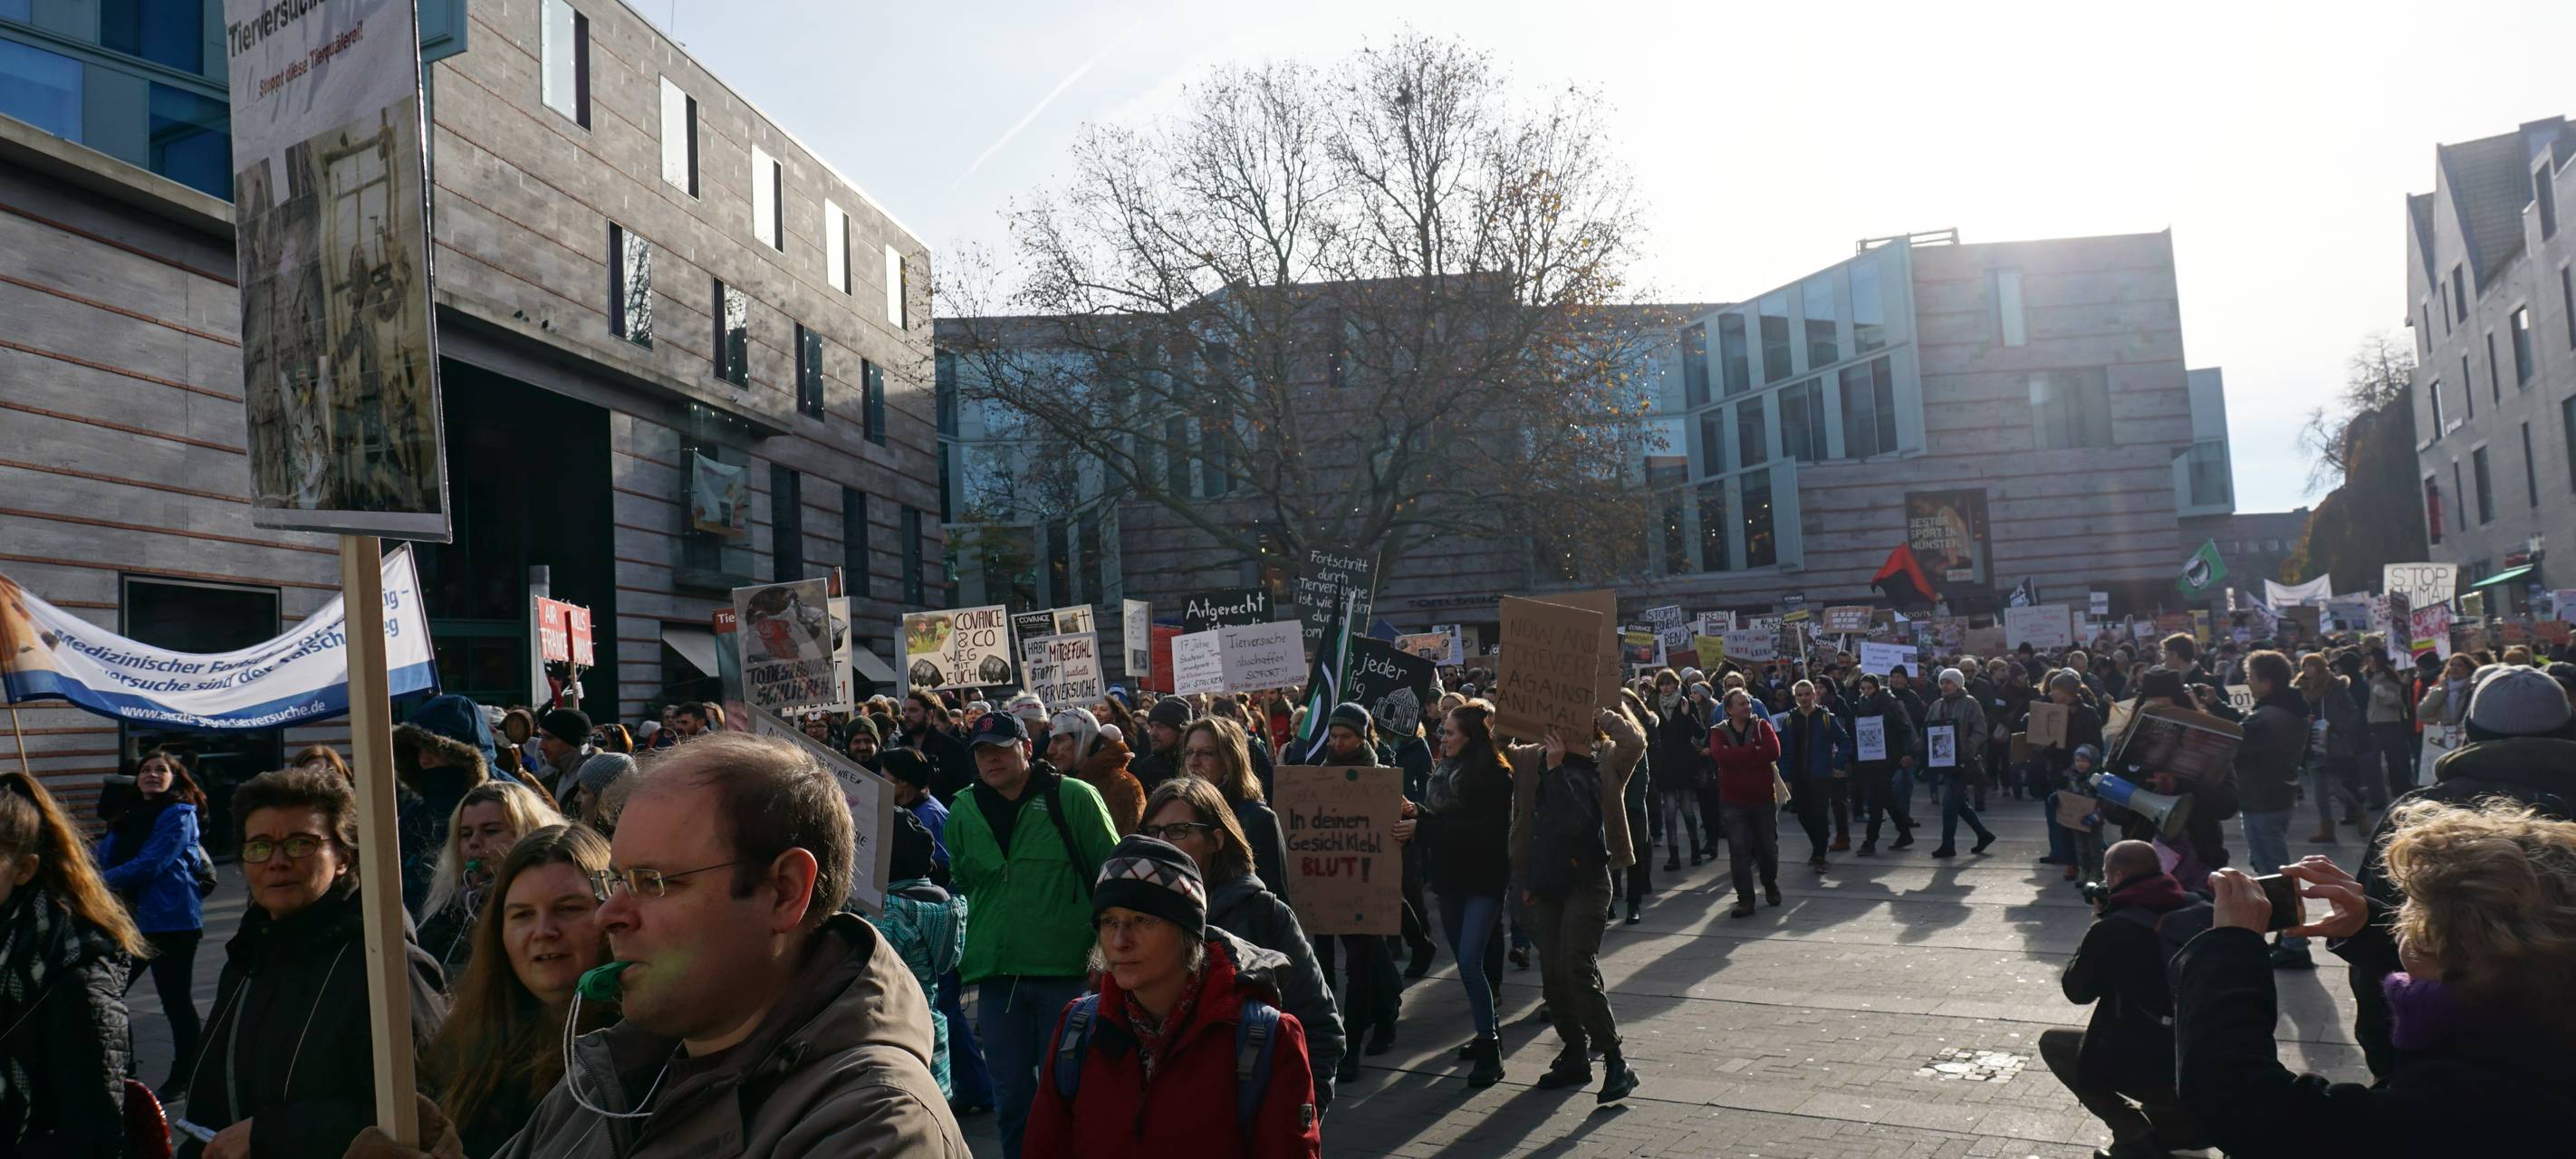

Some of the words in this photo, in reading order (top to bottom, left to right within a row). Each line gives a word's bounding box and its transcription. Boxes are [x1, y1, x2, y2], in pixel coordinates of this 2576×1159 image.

[259, 69, 284, 97] Stoppt
[285, 58, 308, 82] diese
[309, 20, 363, 69] Tierquälerei!
[1312, 550, 1369, 572] Fortschritt
[1317, 567, 1349, 585] durch
[2391, 567, 2449, 588] STOP
[1186, 591, 1265, 621] Artgerecht
[1298, 591, 1313, 606] ist
[1316, 596, 1333, 608] wie
[717, 613, 735, 624] Tie
[955, 608, 1004, 631] COVANCE
[1018, 614, 1051, 625] COVANCE
[1648, 607, 1678, 621] STOPPT
[957, 632, 968, 648] &
[972, 629, 995, 647] CO
[1226, 633, 1287, 649] Tierversuche
[1509, 618, 1555, 646] NOW
[54, 627, 206, 674] Medizinischer
[943, 648, 976, 663] WEG
[1028, 641, 1049, 656] HABT
[1049, 640, 1092, 663] MITGEFÜHL
[238, 666, 274, 685] der
[954, 662, 970, 670] MIT
[1031, 665, 1060, 681] STOPPT
[1357, 652, 1408, 681] jeder
[947, 669, 977, 685] EUCH
[1507, 669, 1593, 704] AGAINST
[1034, 678, 1097, 704] TIERVERSUCHE
[1496, 689, 1577, 725] ANIMAL
[1289, 808, 1305, 830] In
[1311, 806, 1370, 830] deinem
[1287, 831, 1343, 852] Gesicht
